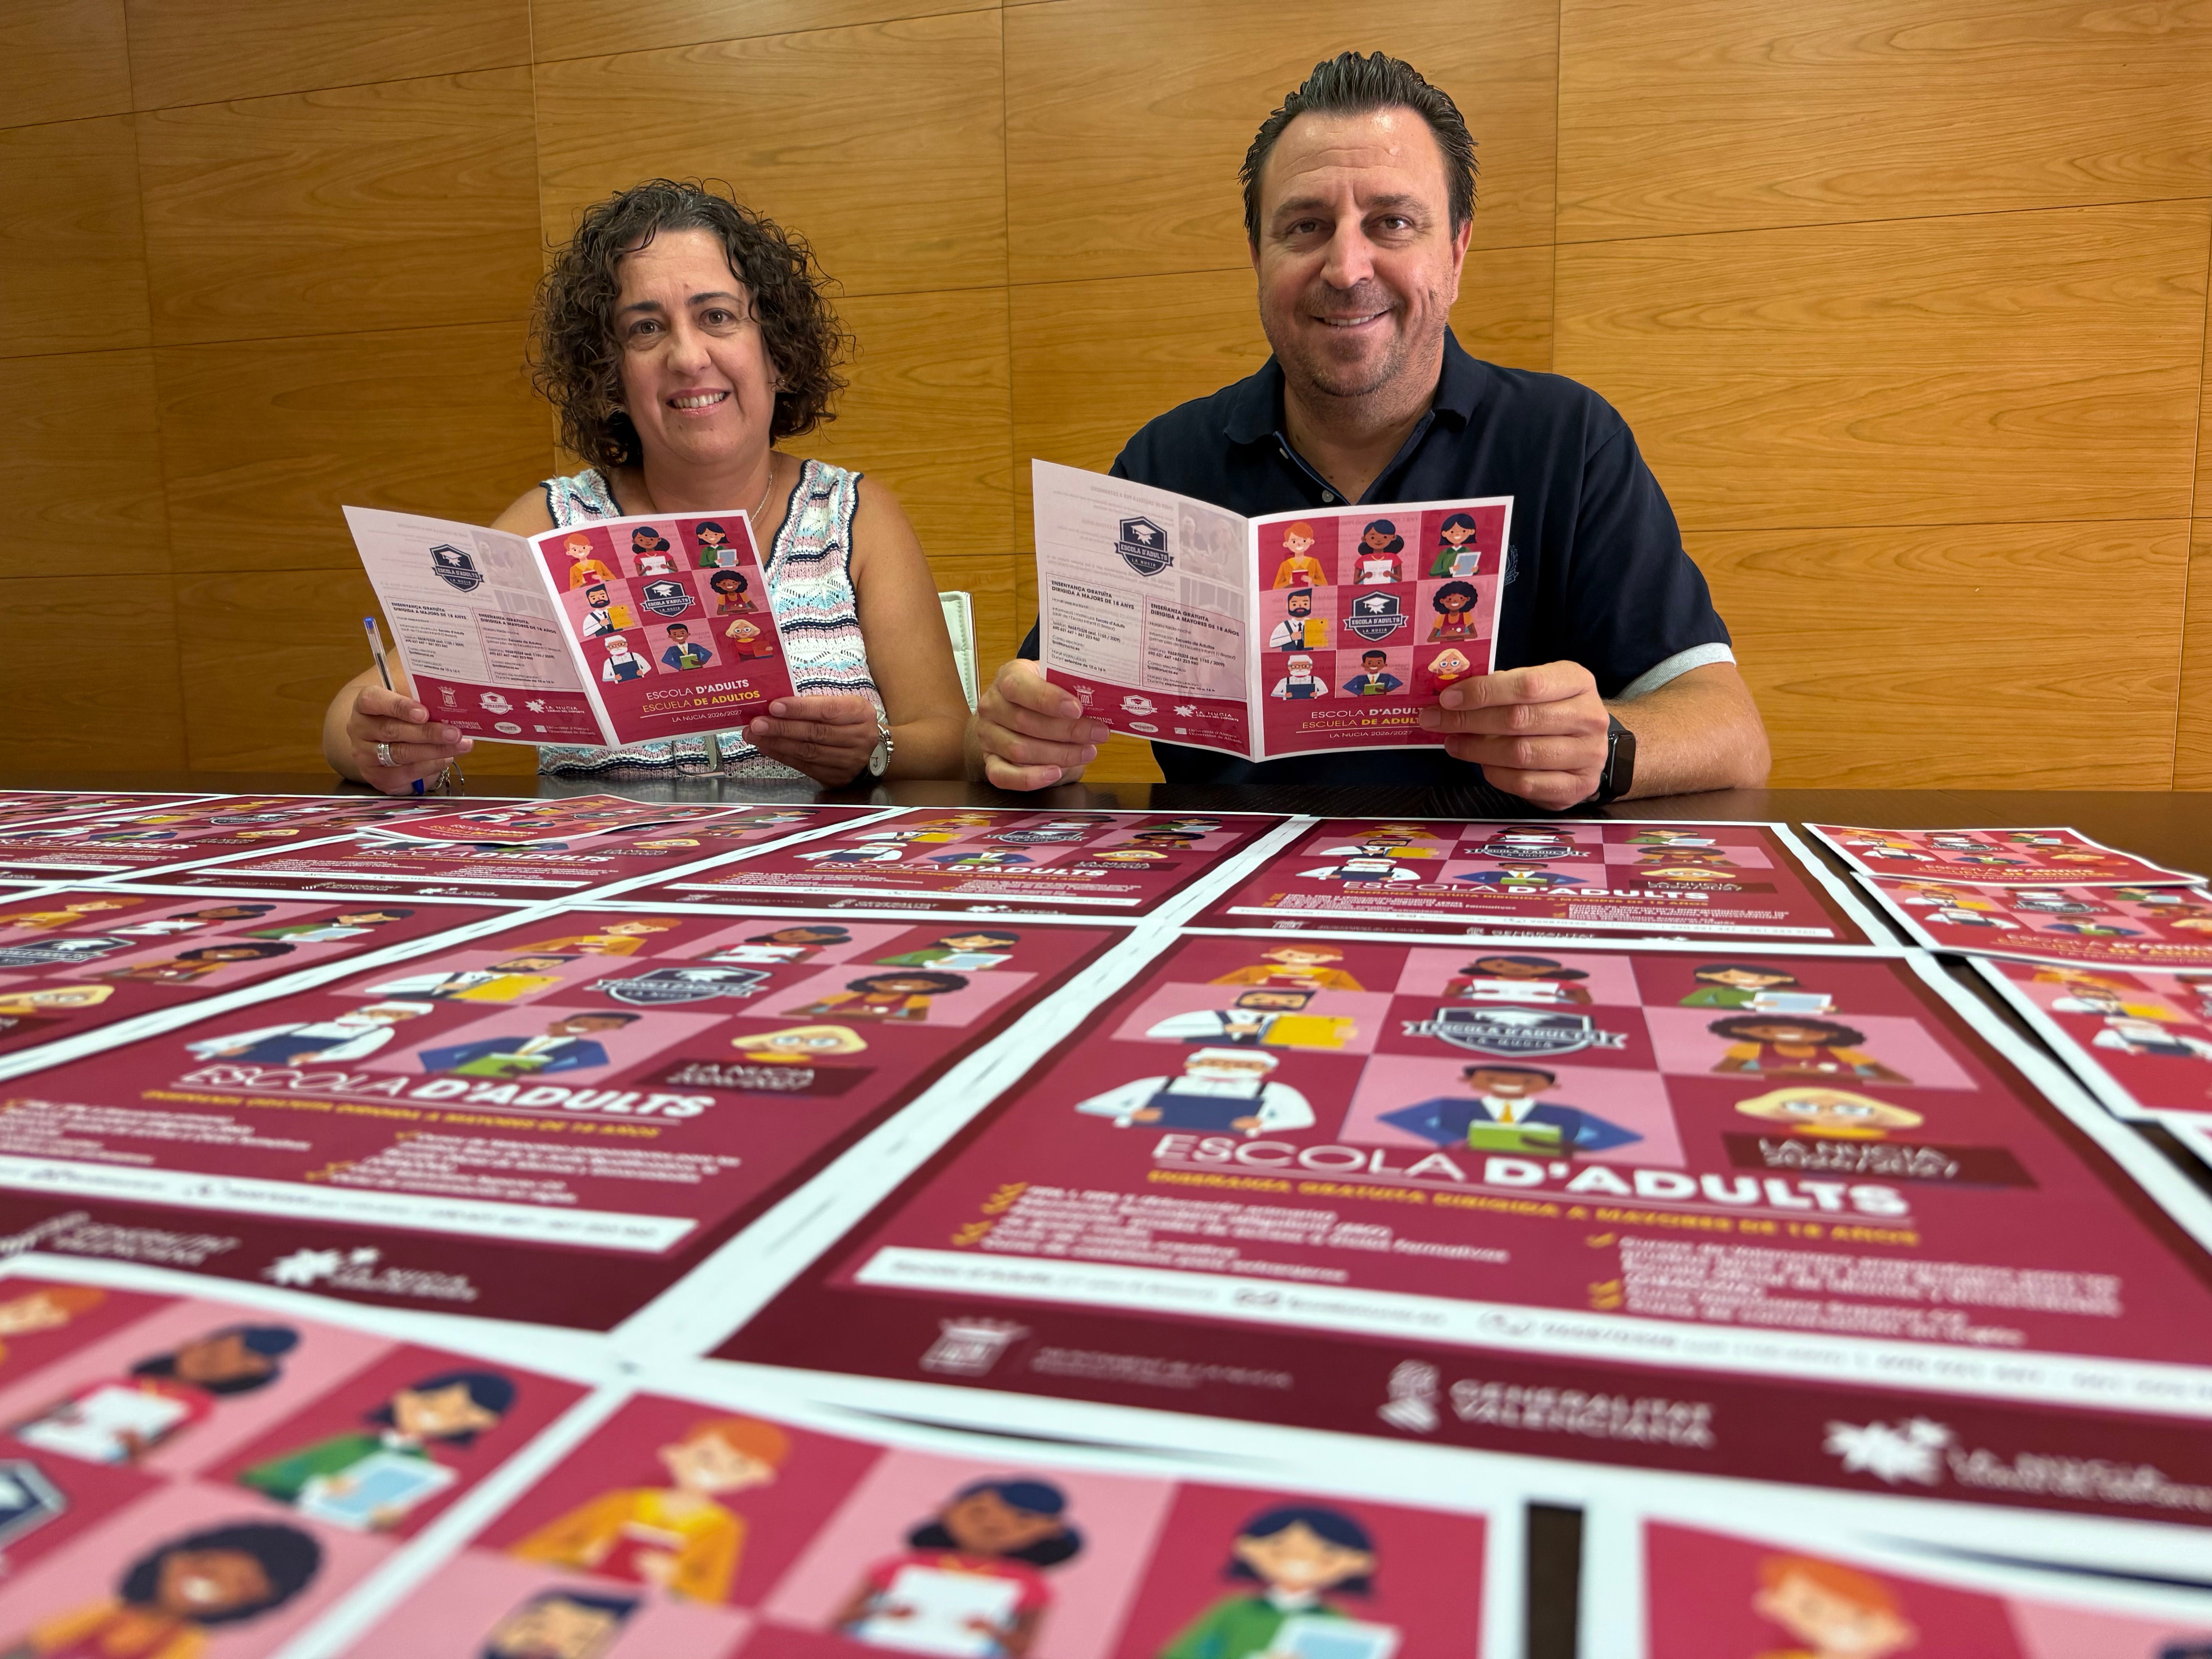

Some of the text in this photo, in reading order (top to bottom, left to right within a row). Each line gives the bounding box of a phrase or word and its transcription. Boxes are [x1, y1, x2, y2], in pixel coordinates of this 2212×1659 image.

[1121, 544, 1168, 560] ESCOLA D'ADULTS
[1052, 580, 1112, 598] ENSENYANÇA GRATUÏTA
[1052, 587, 1075, 595] DIRIGIDA
[1082, 593, 1103, 602] MAJORS
[1151, 603, 1209, 622] ENSEÑANZA GRATUITA
[1151, 609, 1175, 619] DIRIGIDA
[1182, 617, 1207, 627] MAYORES
[1224, 628, 1239, 636] AÑOS
[646, 679, 749, 700] ESCOLA D'ADULTS
[643, 700, 691, 713] ESCUELA
[712, 690, 760, 704] ADULTOS
[708, 710, 742, 718] 2026/2027
[1312, 708, 1424, 718] ESCOLA D'ADULT
[1303, 720, 1357, 728] ESCUELA
[471, 852, 615, 862] D'ADULTS
[947, 865, 1108, 876] D'ADULTS
[1343, 881, 1709, 899] ESCOLA D'ADULTS
[181, 1065, 716, 1118] ESCOLA D'ADULTS
[1153, 1133, 1910, 1216] ESCOLA D'ADULTS
[1449, 1379, 1713, 1422] GENERALITAT
